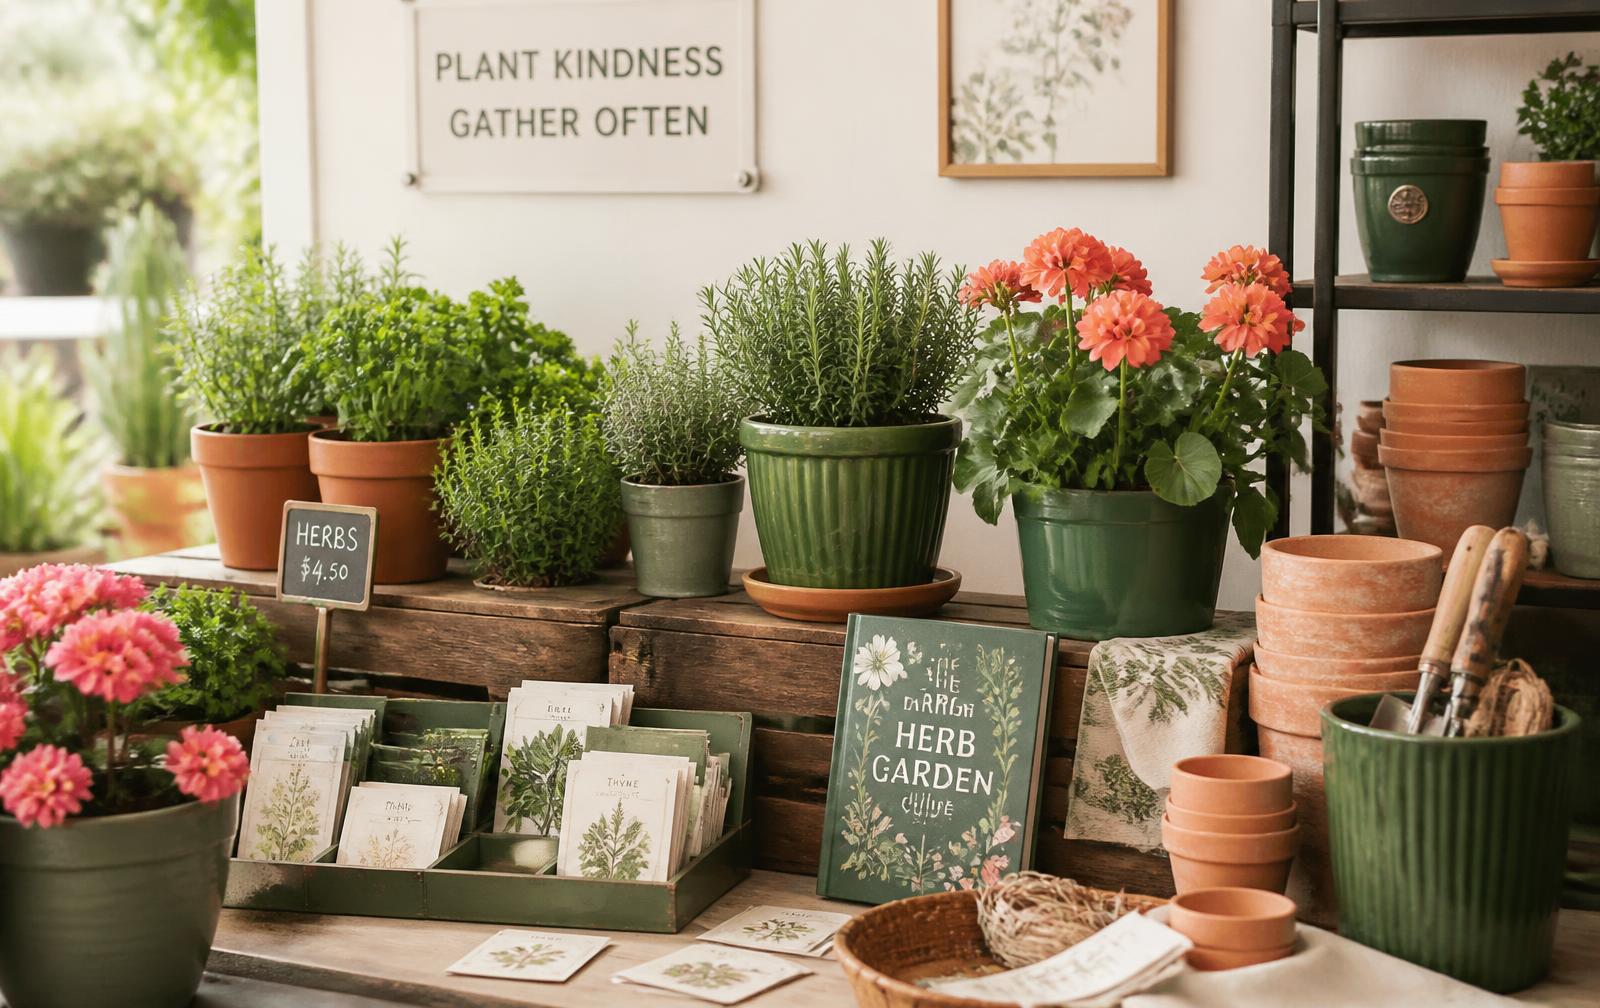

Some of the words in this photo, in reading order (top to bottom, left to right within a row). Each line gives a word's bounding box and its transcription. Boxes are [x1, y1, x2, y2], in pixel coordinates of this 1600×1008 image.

[435, 50, 539, 81] PLANT
[554, 46, 723, 79] KINDNESS
[450, 107, 580, 138] GATHER
[595, 106, 709, 137] OFTEN
[296, 521, 358, 552] HERBS
[301, 555, 349, 586] $4.50
[895, 720, 976, 758] HERB
[872, 754, 994, 796] GARDEN
